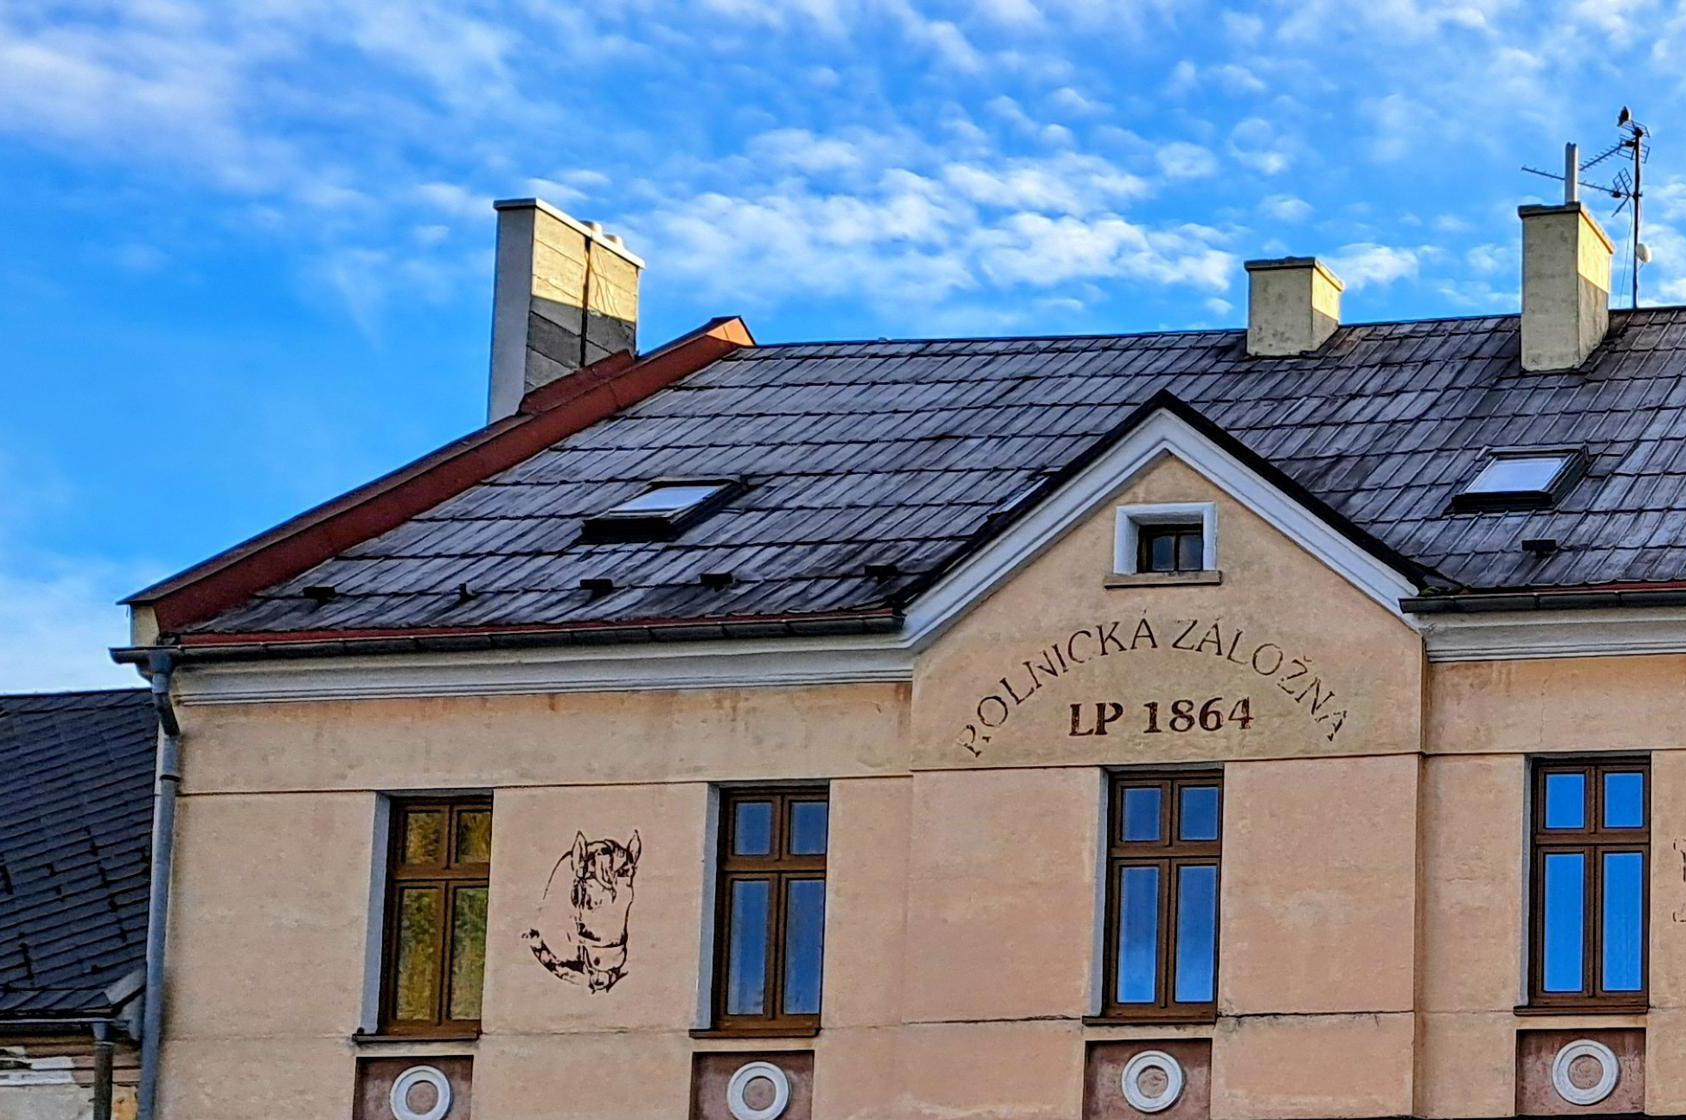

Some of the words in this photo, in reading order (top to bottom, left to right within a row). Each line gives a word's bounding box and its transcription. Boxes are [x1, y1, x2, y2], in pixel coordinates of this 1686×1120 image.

[957, 609, 1159, 757] ROLNICKÁ
[1171, 615, 1348, 741] ZÁLOŽNA
[1069, 702, 1124, 736] LP
[1144, 697, 1254, 734] 1864
